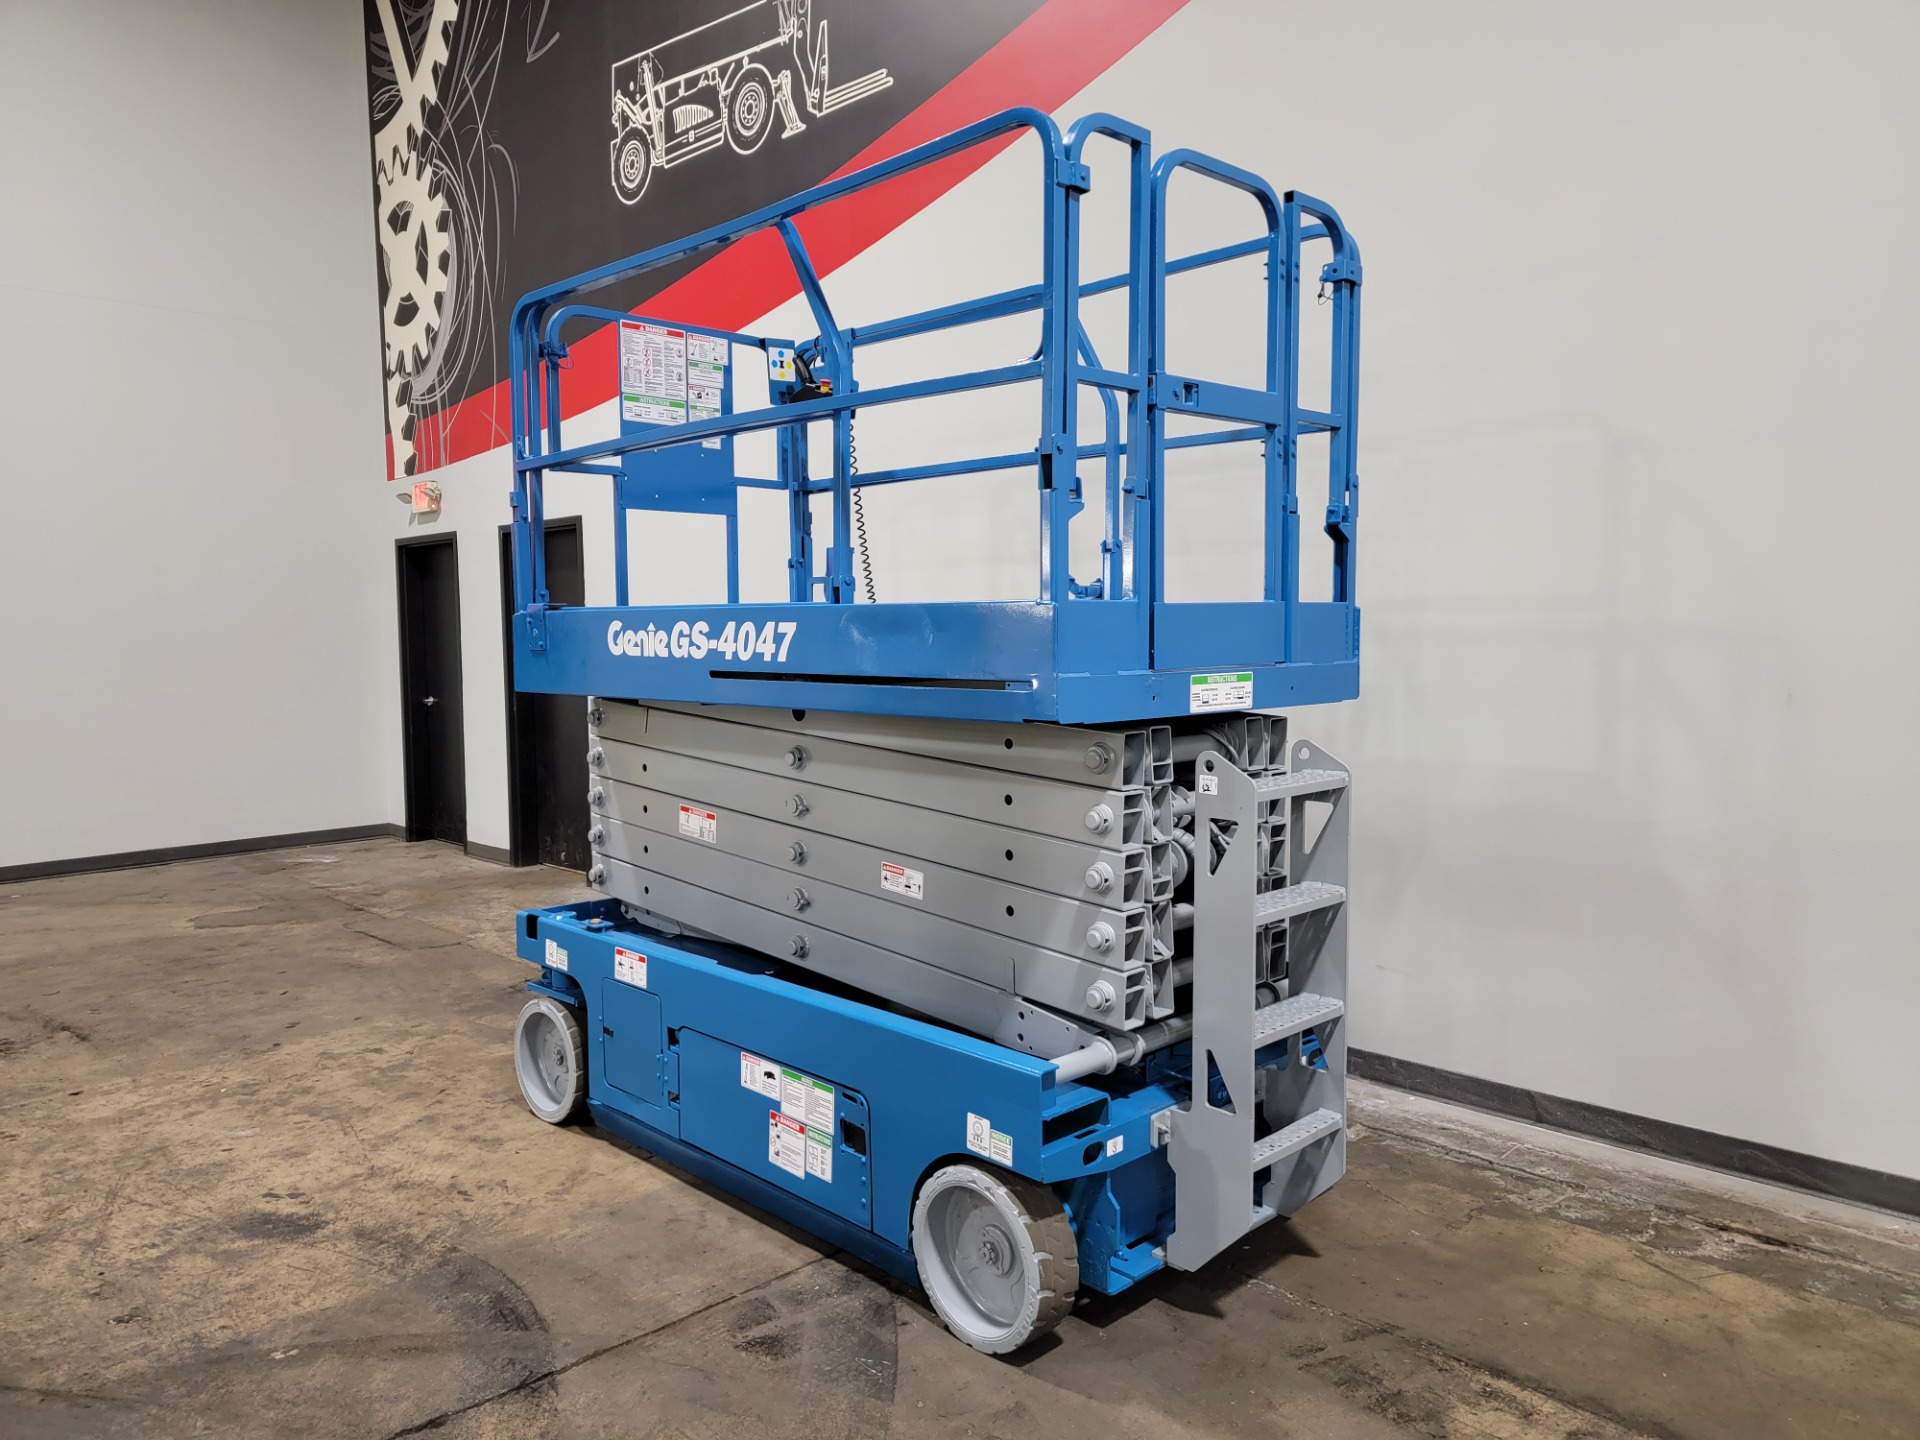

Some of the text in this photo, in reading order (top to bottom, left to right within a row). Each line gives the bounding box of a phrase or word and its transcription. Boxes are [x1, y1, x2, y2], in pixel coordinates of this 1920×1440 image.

[645, 325, 667, 335] DANGER
[607, 620, 797, 662] Genie GS-4047
[780, 1116, 800, 1131] DANGER
